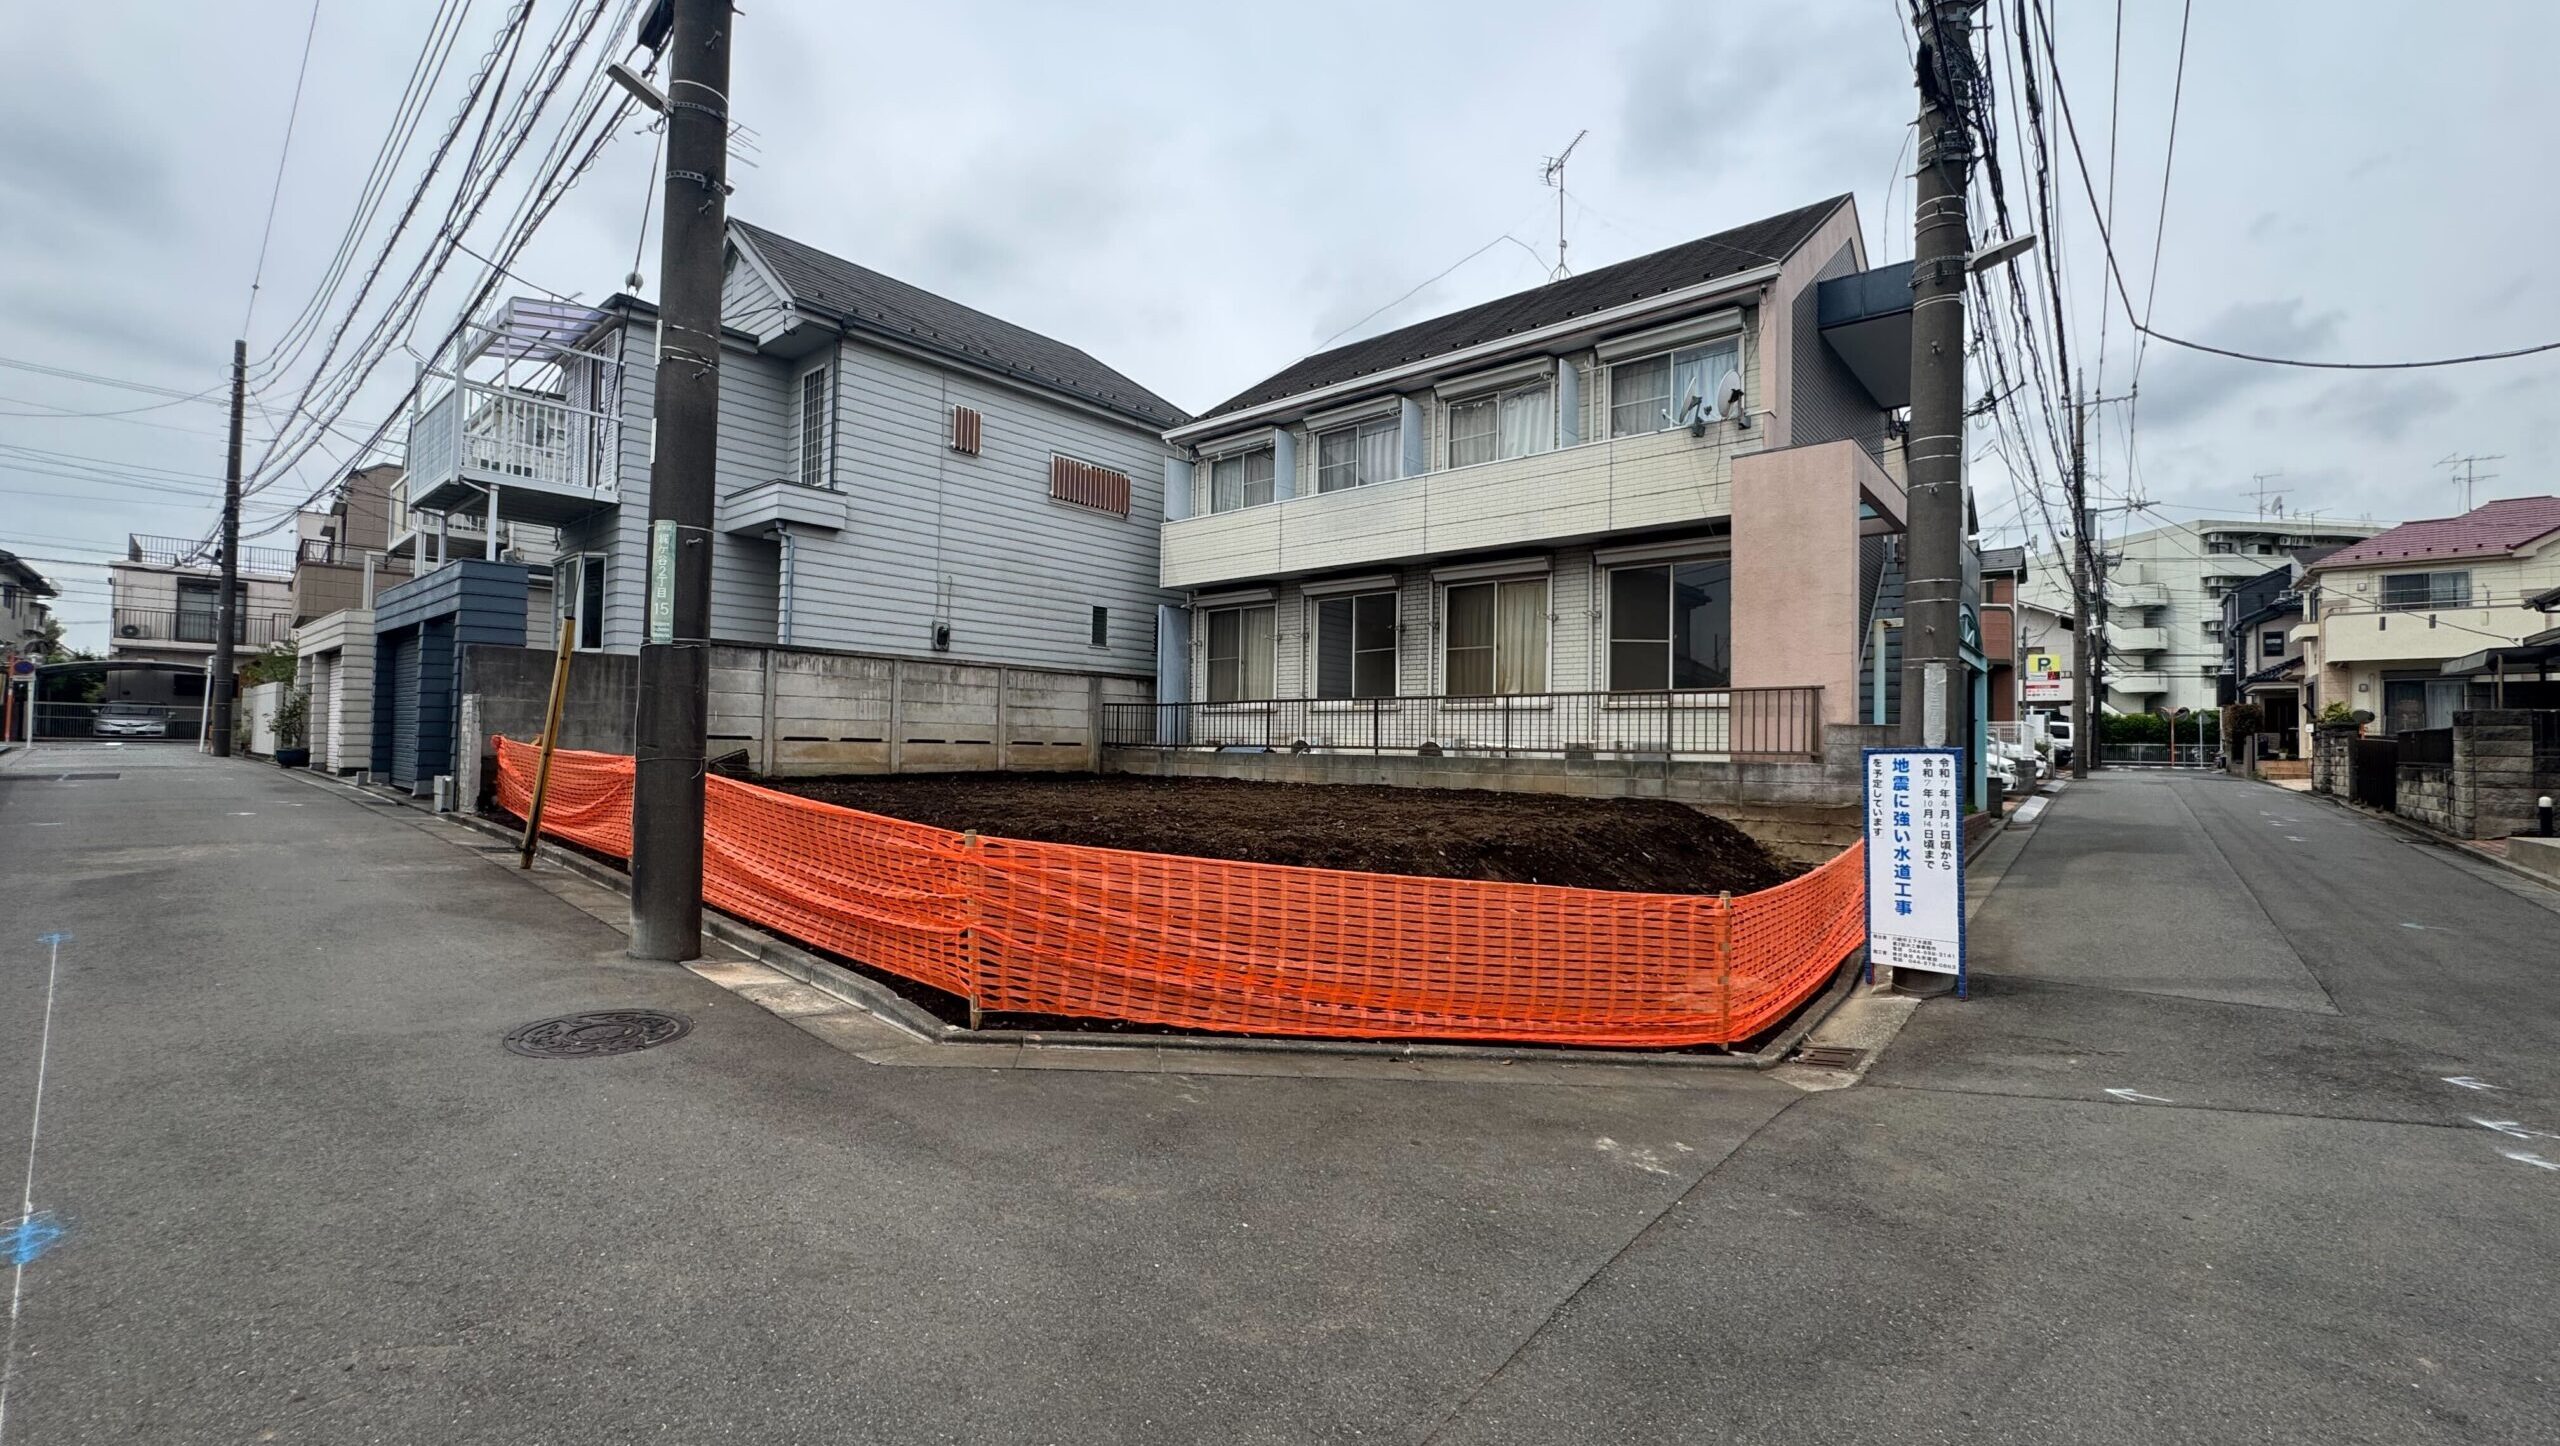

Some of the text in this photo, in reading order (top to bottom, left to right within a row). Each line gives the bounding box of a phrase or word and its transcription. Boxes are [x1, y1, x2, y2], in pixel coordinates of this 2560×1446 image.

[654, 602, 669, 616] 15
[2038, 658, 2051, 671] P
[1872, 758, 1883, 837] を予定しています
[1892, 758, 1912, 916] 地震に強い水道工事
